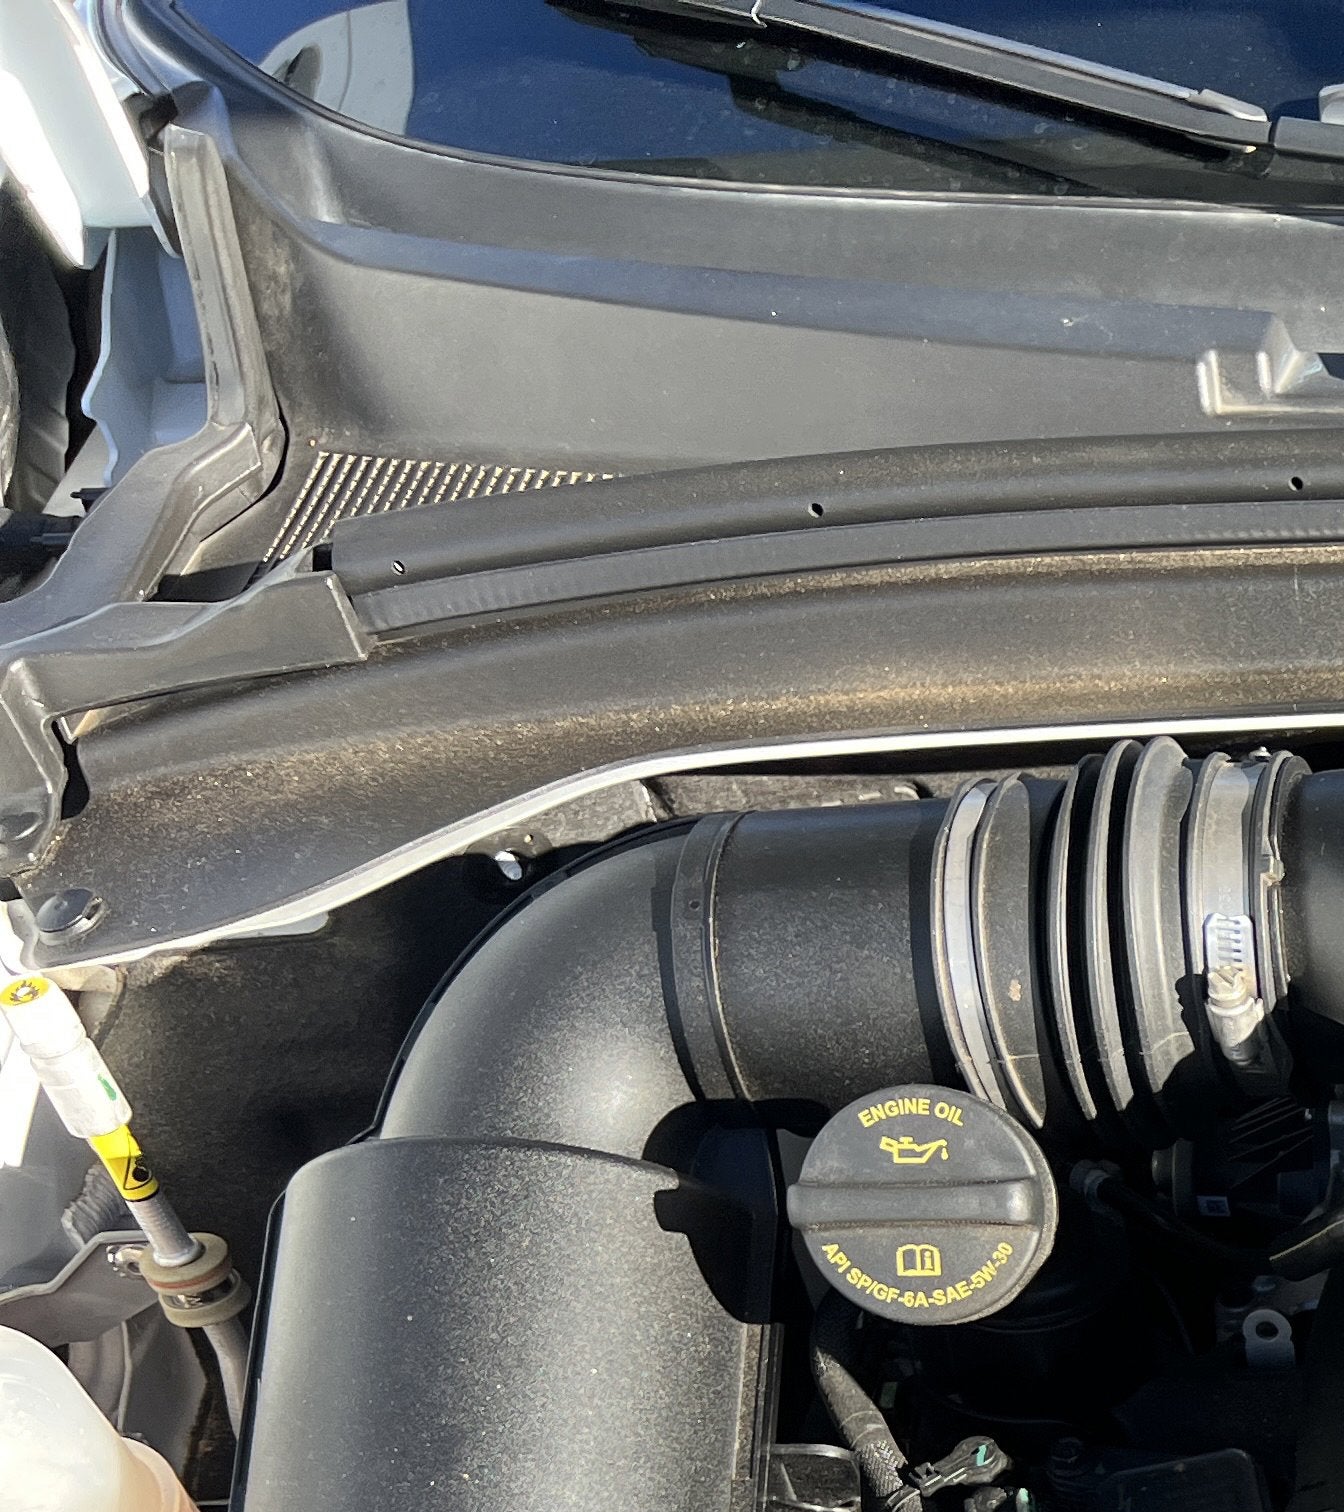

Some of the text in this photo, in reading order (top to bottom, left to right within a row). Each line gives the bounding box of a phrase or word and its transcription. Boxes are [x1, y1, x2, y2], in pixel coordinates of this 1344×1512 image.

[858, 1098, 965, 1128] ENGINE OIL
[822, 1243, 847, 1273] API
